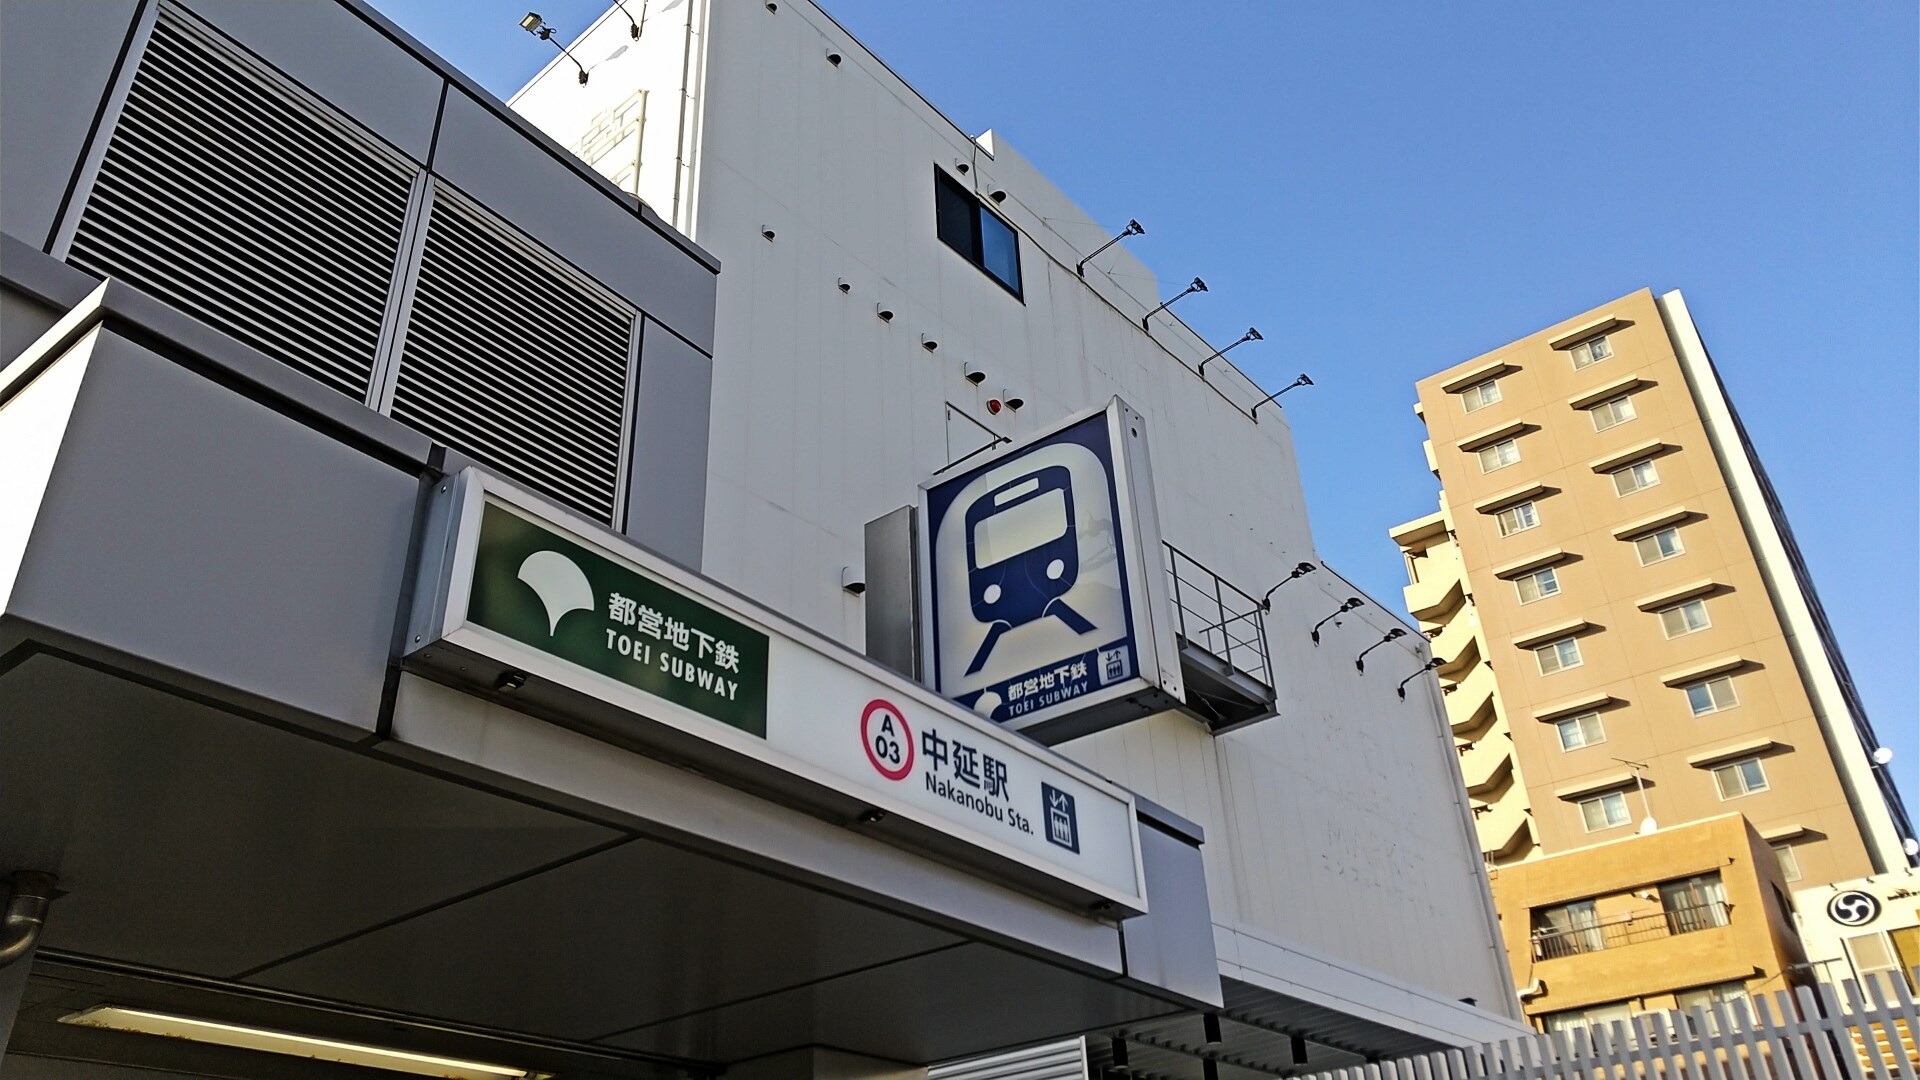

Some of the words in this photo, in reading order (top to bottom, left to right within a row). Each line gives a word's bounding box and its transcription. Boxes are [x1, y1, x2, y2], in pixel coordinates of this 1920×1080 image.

[608, 592, 739, 674] 都営地下鉄
[606, 628, 650, 665] TOEI
[659, 652, 738, 701] SUBWAY
[1008, 661, 1088, 702] 都営地下鉄
[881, 714, 895, 737] A
[1008, 699, 1034, 717] TOEI
[1039, 681, 1088, 707] SUBWAY
[875, 735, 900, 764] 03
[921, 728, 1010, 802] 中延駅
[925, 771, 1004, 822] Nakanobu
[1008, 808, 1034, 836] Sta.
